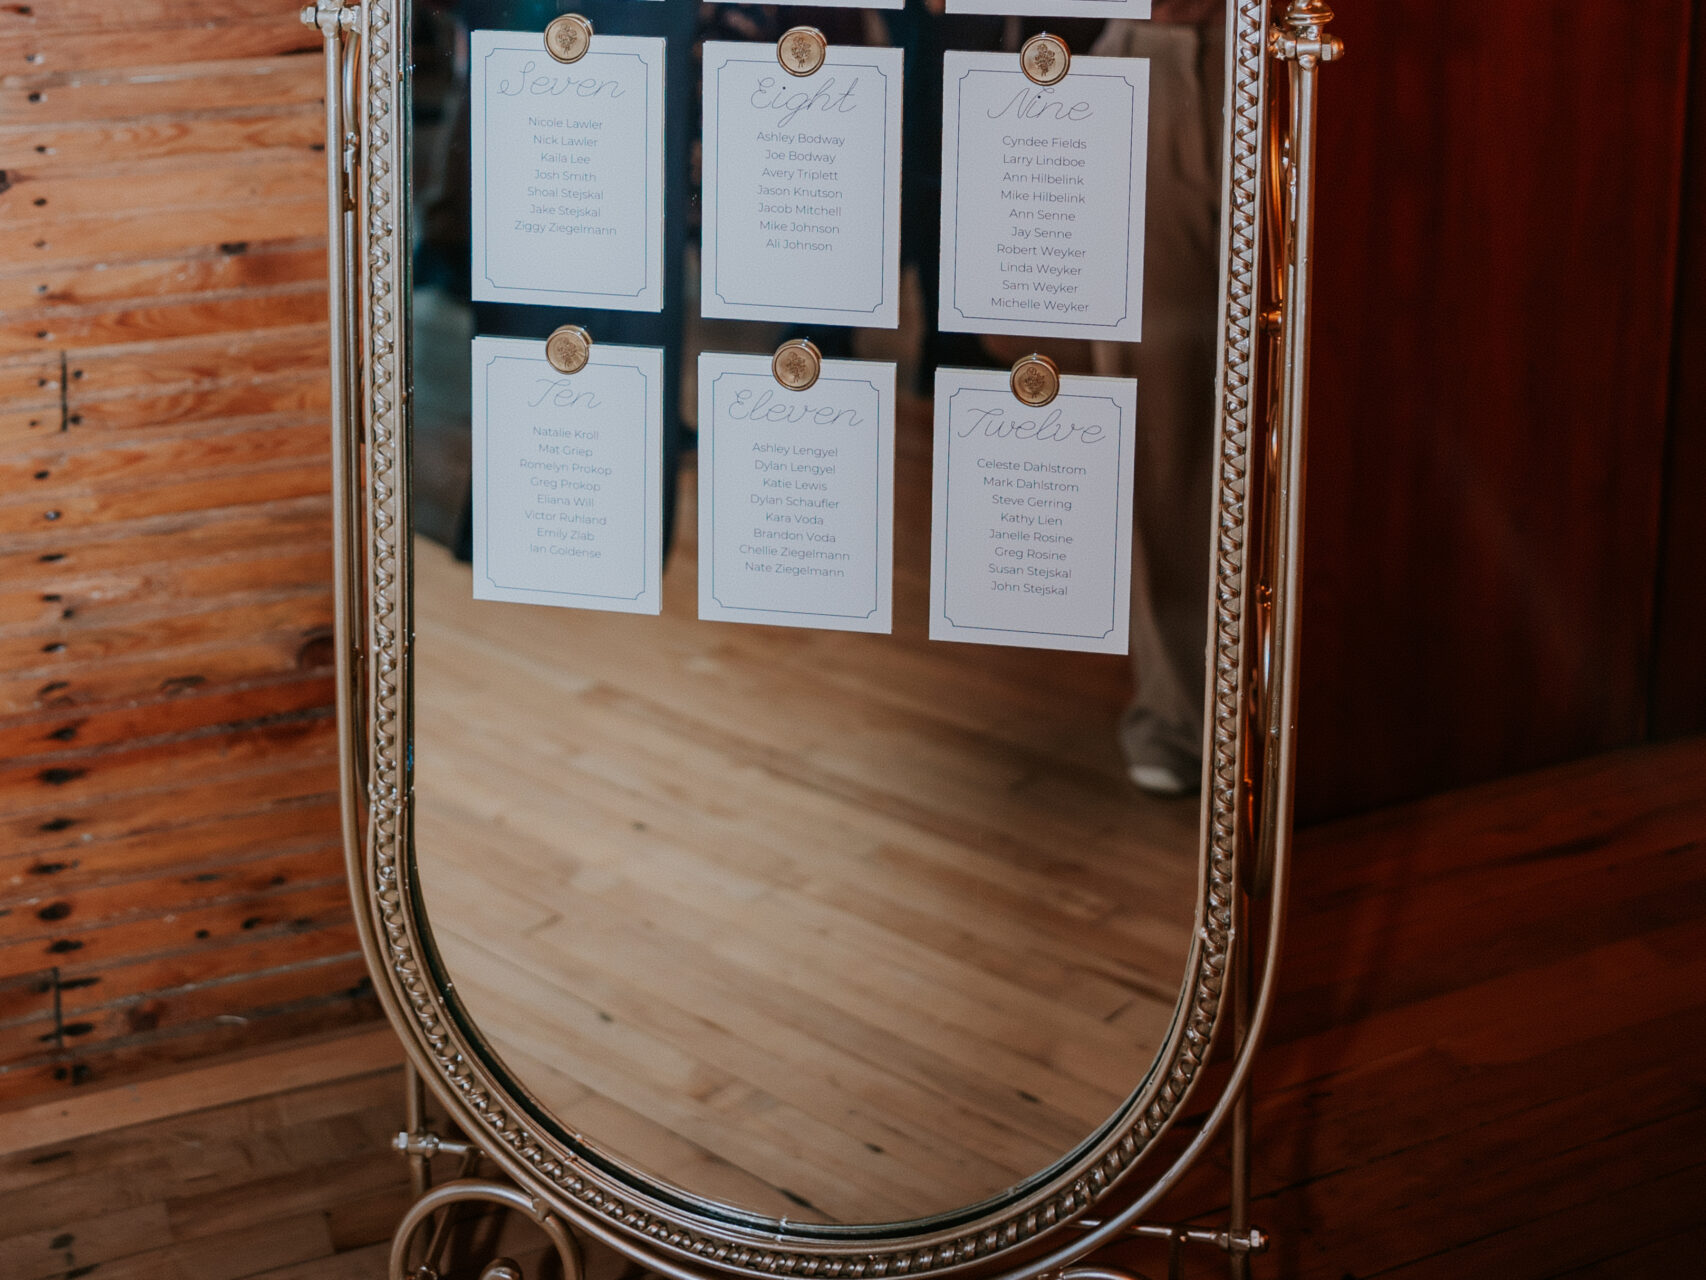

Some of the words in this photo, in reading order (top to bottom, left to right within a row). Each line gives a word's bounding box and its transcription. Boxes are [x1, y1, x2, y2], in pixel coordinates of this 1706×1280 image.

[497, 61, 626, 98] Seven
[751, 77, 858, 128] Eight
[986, 87, 1094, 121] Nine
[757, 131, 795, 144] Ashley
[798, 133, 845, 147] Bodway
[1002, 136, 1048, 150] Cyndee
[1052, 137, 1087, 150] Fields
[765, 150, 785, 161] Joe
[789, 151, 836, 164] Bodway
[1003, 155, 1033, 168] Larry
[1036, 156, 1086, 168] Lindboe
[762, 168, 794, 181] Avery
[798, 169, 838, 182] Triplett
[1003, 173, 1027, 184] Ann
[1032, 174, 1084, 186] Hilbelink
[1001, 190, 1030, 202] Mike
[1033, 192, 1086, 204] Hilbelink
[1009, 209, 1034, 220] Ann
[1038, 210, 1076, 222] Senne
[760, 221, 787, 232] Mike
[790, 222, 840, 234] Johnson
[1012, 227, 1031, 240] Jay
[1034, 228, 1072, 240] Senne
[1000, 262, 1032, 274] Linda
[1036, 264, 1082, 277] Weyker
[1002, 281, 1029, 292] Sam
[1033, 282, 1078, 295] Weyker
[992, 298, 1040, 310] Michelle
[1044, 300, 1089, 313] Weyker
[528, 378, 602, 409] Ten
[728, 389, 864, 427] Eleven
[957, 408, 1106, 444] Twelve
[752, 443, 790, 456] Ashley
[793, 445, 838, 458] Lengyel
[755, 460, 787, 473] Dylan
[791, 462, 836, 475] Lengyel
[977, 458, 1020, 470] Celeste
[1024, 461, 1086, 475] Dahlstrom
[984, 477, 1013, 488] Mark
[1017, 479, 1079, 492] Dahlstrom
[754, 529, 803, 541] Brandon
[806, 531, 836, 543] Voda
[989, 529, 1030, 541] Janelle
[1034, 532, 1073, 544] Rosine
[995, 547, 1023, 560] Greg
[1027, 549, 1067, 560] Rosine
[745, 562, 772, 573] Nate
[775, 564, 844, 578] Ziegelmann
[988, 564, 1023, 575] Susan
[1027, 566, 1072, 579] Stejskal
[991, 581, 1020, 592] John
[1024, 583, 1067, 597] Stejskal
